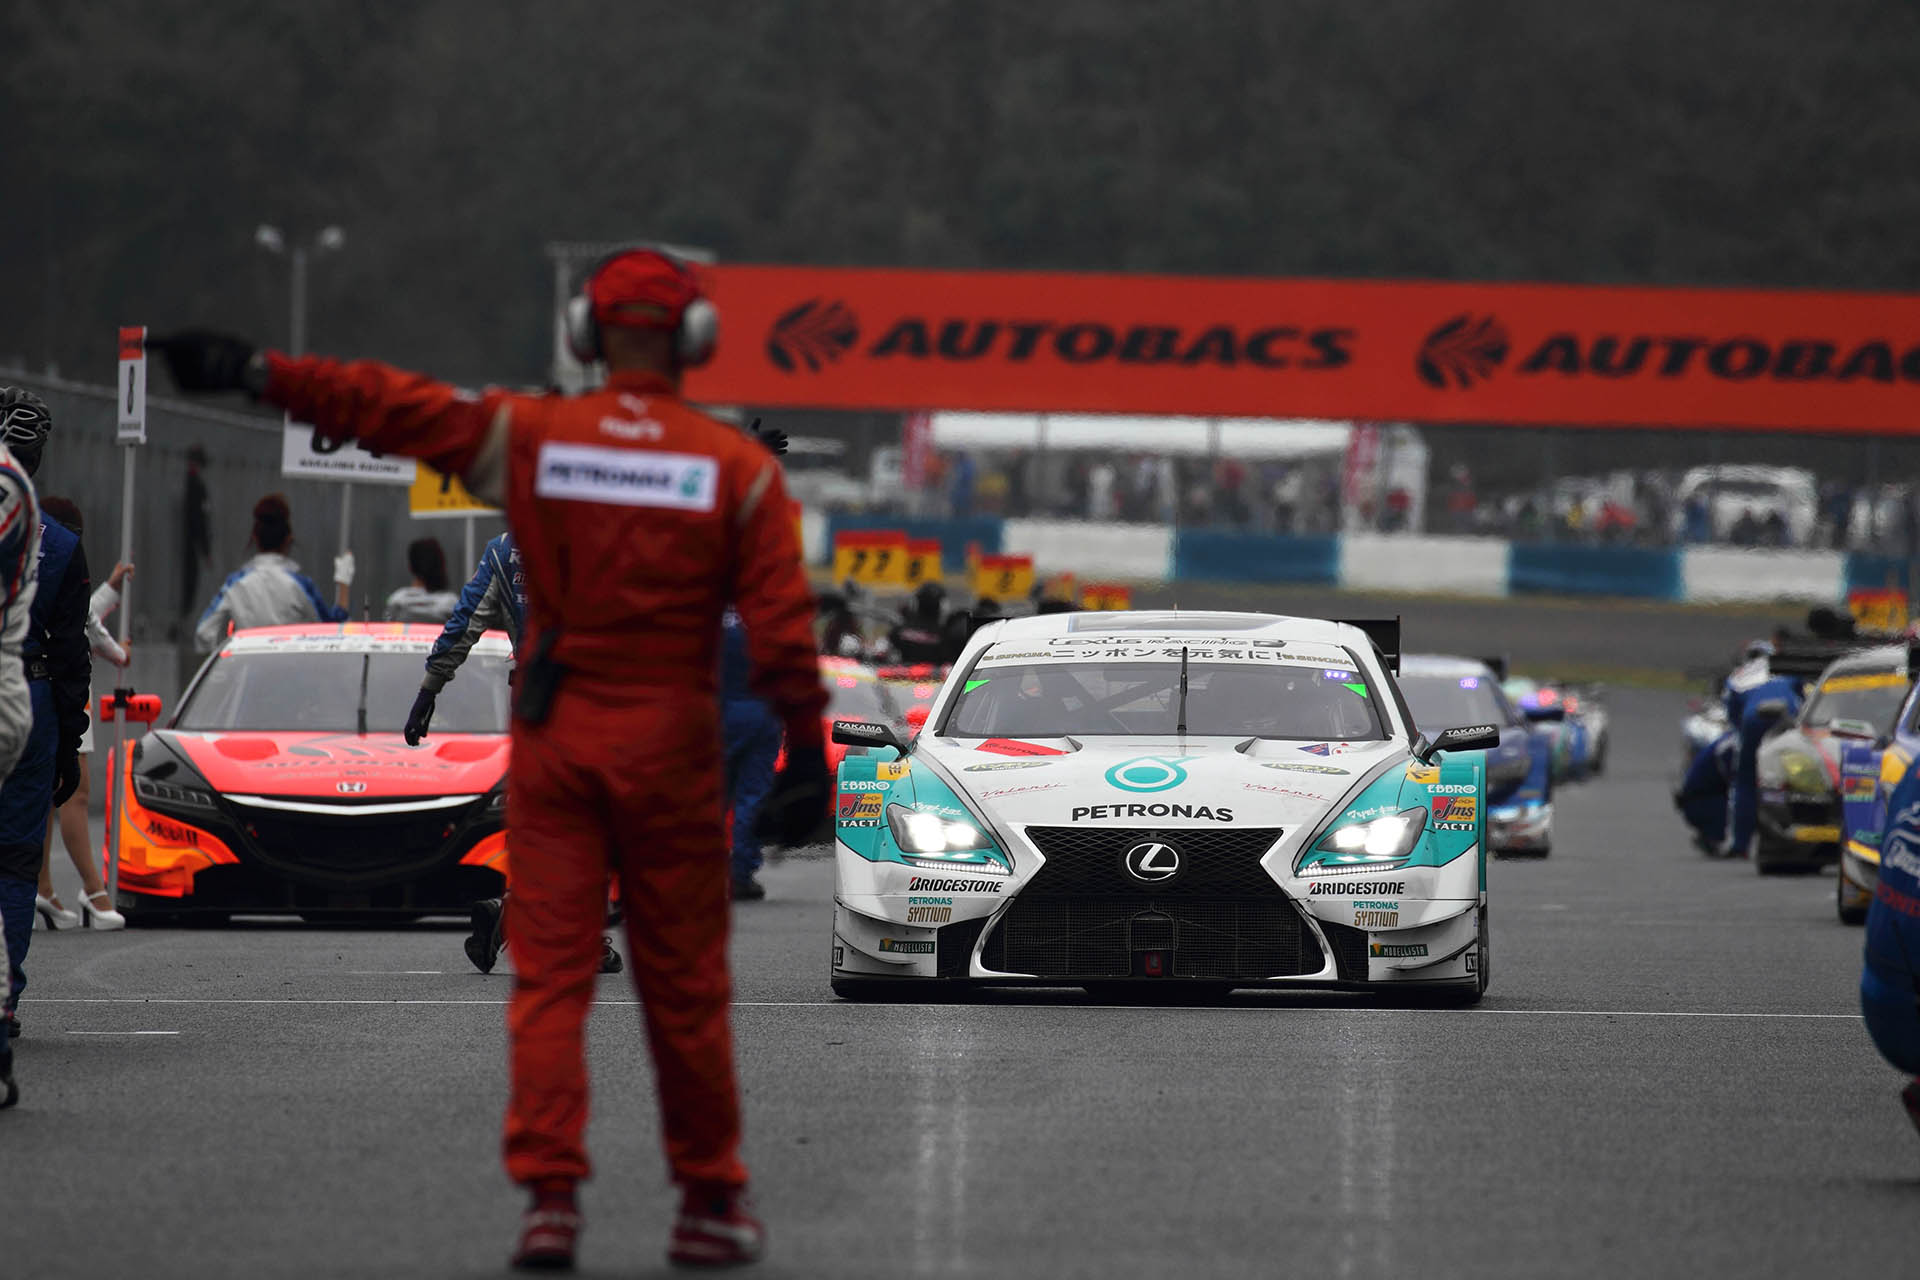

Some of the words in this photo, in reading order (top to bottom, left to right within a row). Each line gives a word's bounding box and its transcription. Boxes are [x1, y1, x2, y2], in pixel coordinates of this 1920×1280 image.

[869, 318, 1355, 369] AUTOBACS
[838, 722, 885, 734] TAKAMA
[1446, 726, 1495, 737] TAKAMA
[840, 781, 890, 790] EBBRO
[1427, 784, 1477, 794] EBBRO
[1072, 803, 1234, 822] PETRONAS
[841, 819, 880, 828] TACTI
[1433, 822, 1473, 831] TACTI
[909, 877, 1004, 893] BRIDGESTONE
[1309, 882, 1405, 895] BRIDGESTONE
[908, 897, 952, 905] PETRONAS
[1353, 901, 1399, 910] PETRONAS
[907, 907, 952, 922] SYNTIUM
[1354, 911, 1399, 927] SYNTIUM
